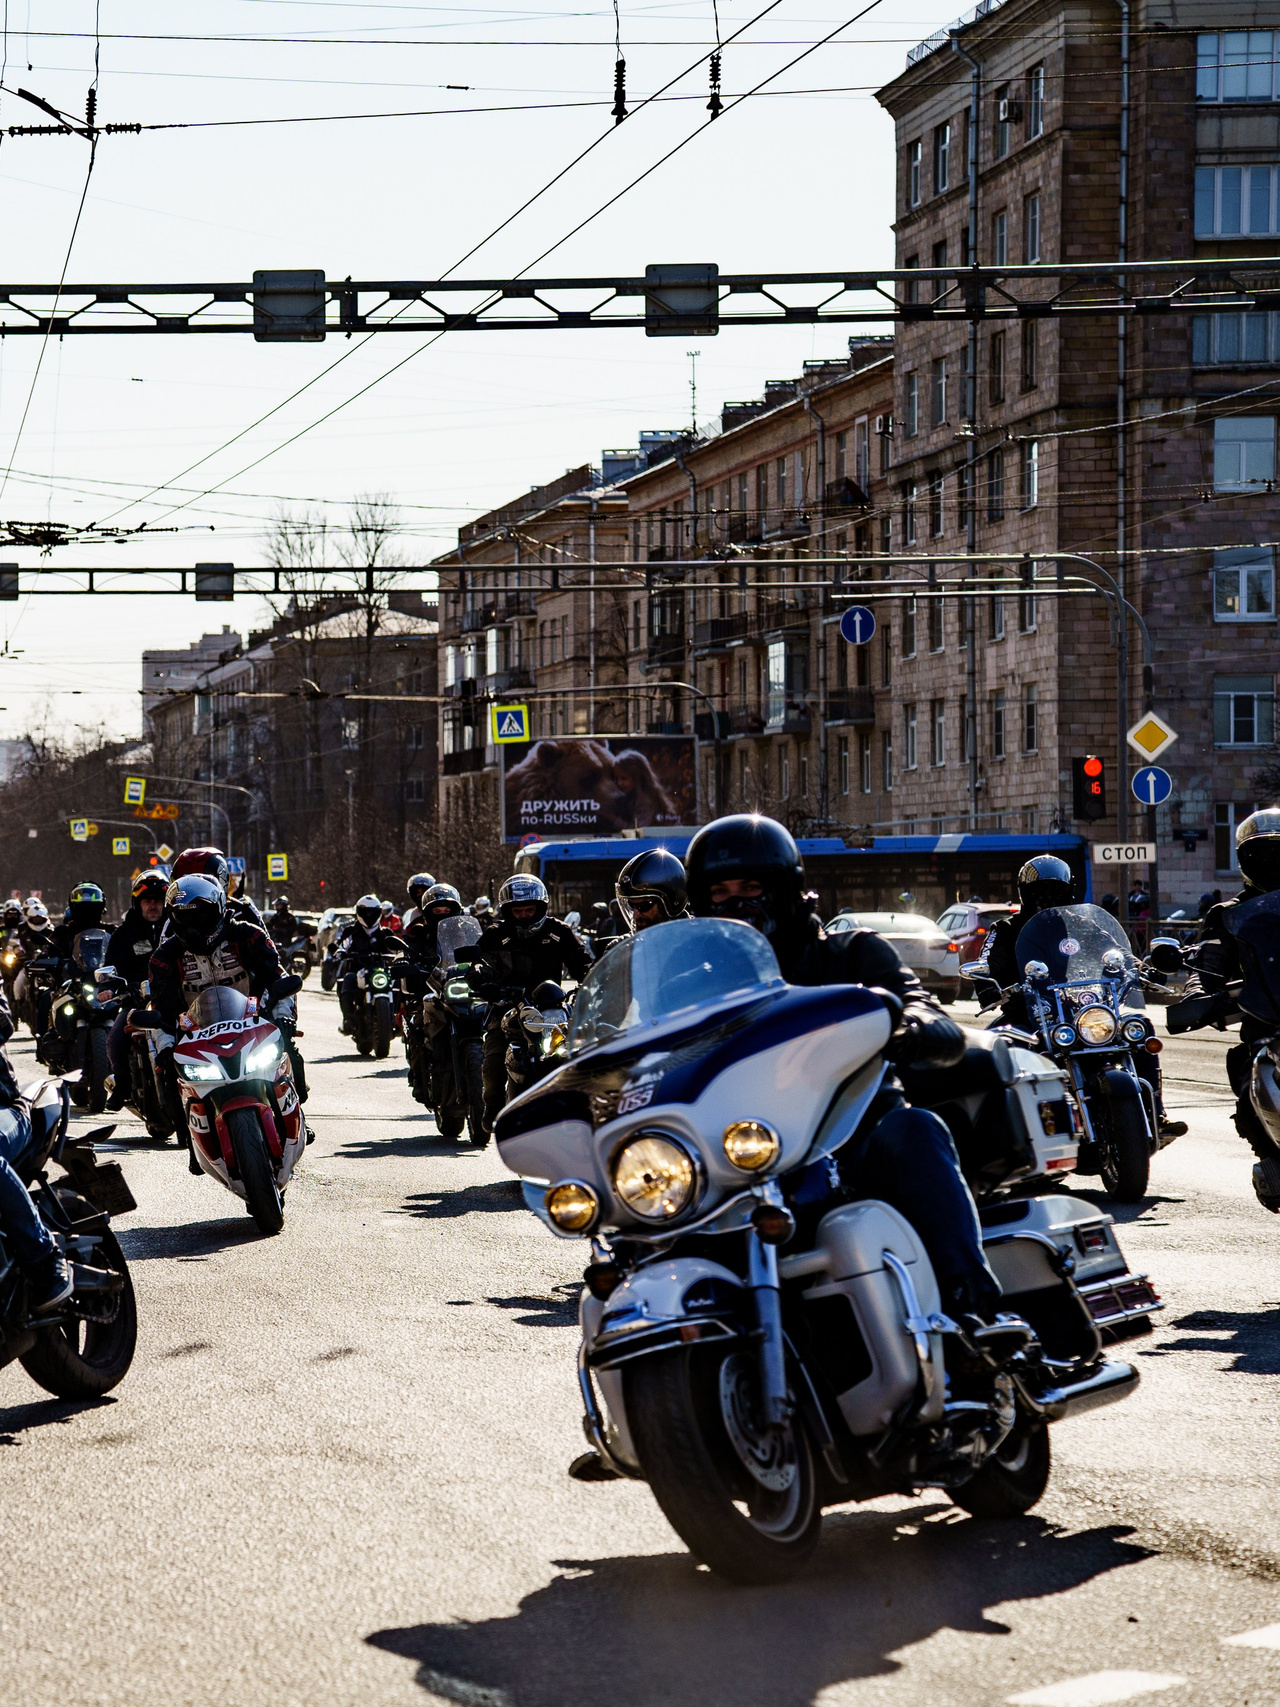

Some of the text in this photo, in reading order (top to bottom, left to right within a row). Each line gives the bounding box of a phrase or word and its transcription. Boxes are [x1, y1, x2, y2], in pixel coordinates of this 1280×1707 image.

[1091, 781, 1101, 794] 16
[520, 799, 600, 813] ДРУЖИТЬ
[521, 813, 597, 825] по-RUSSки
[1102, 846, 1147, 861] СТОП
[197, 1020, 251, 1040] REPSOL
